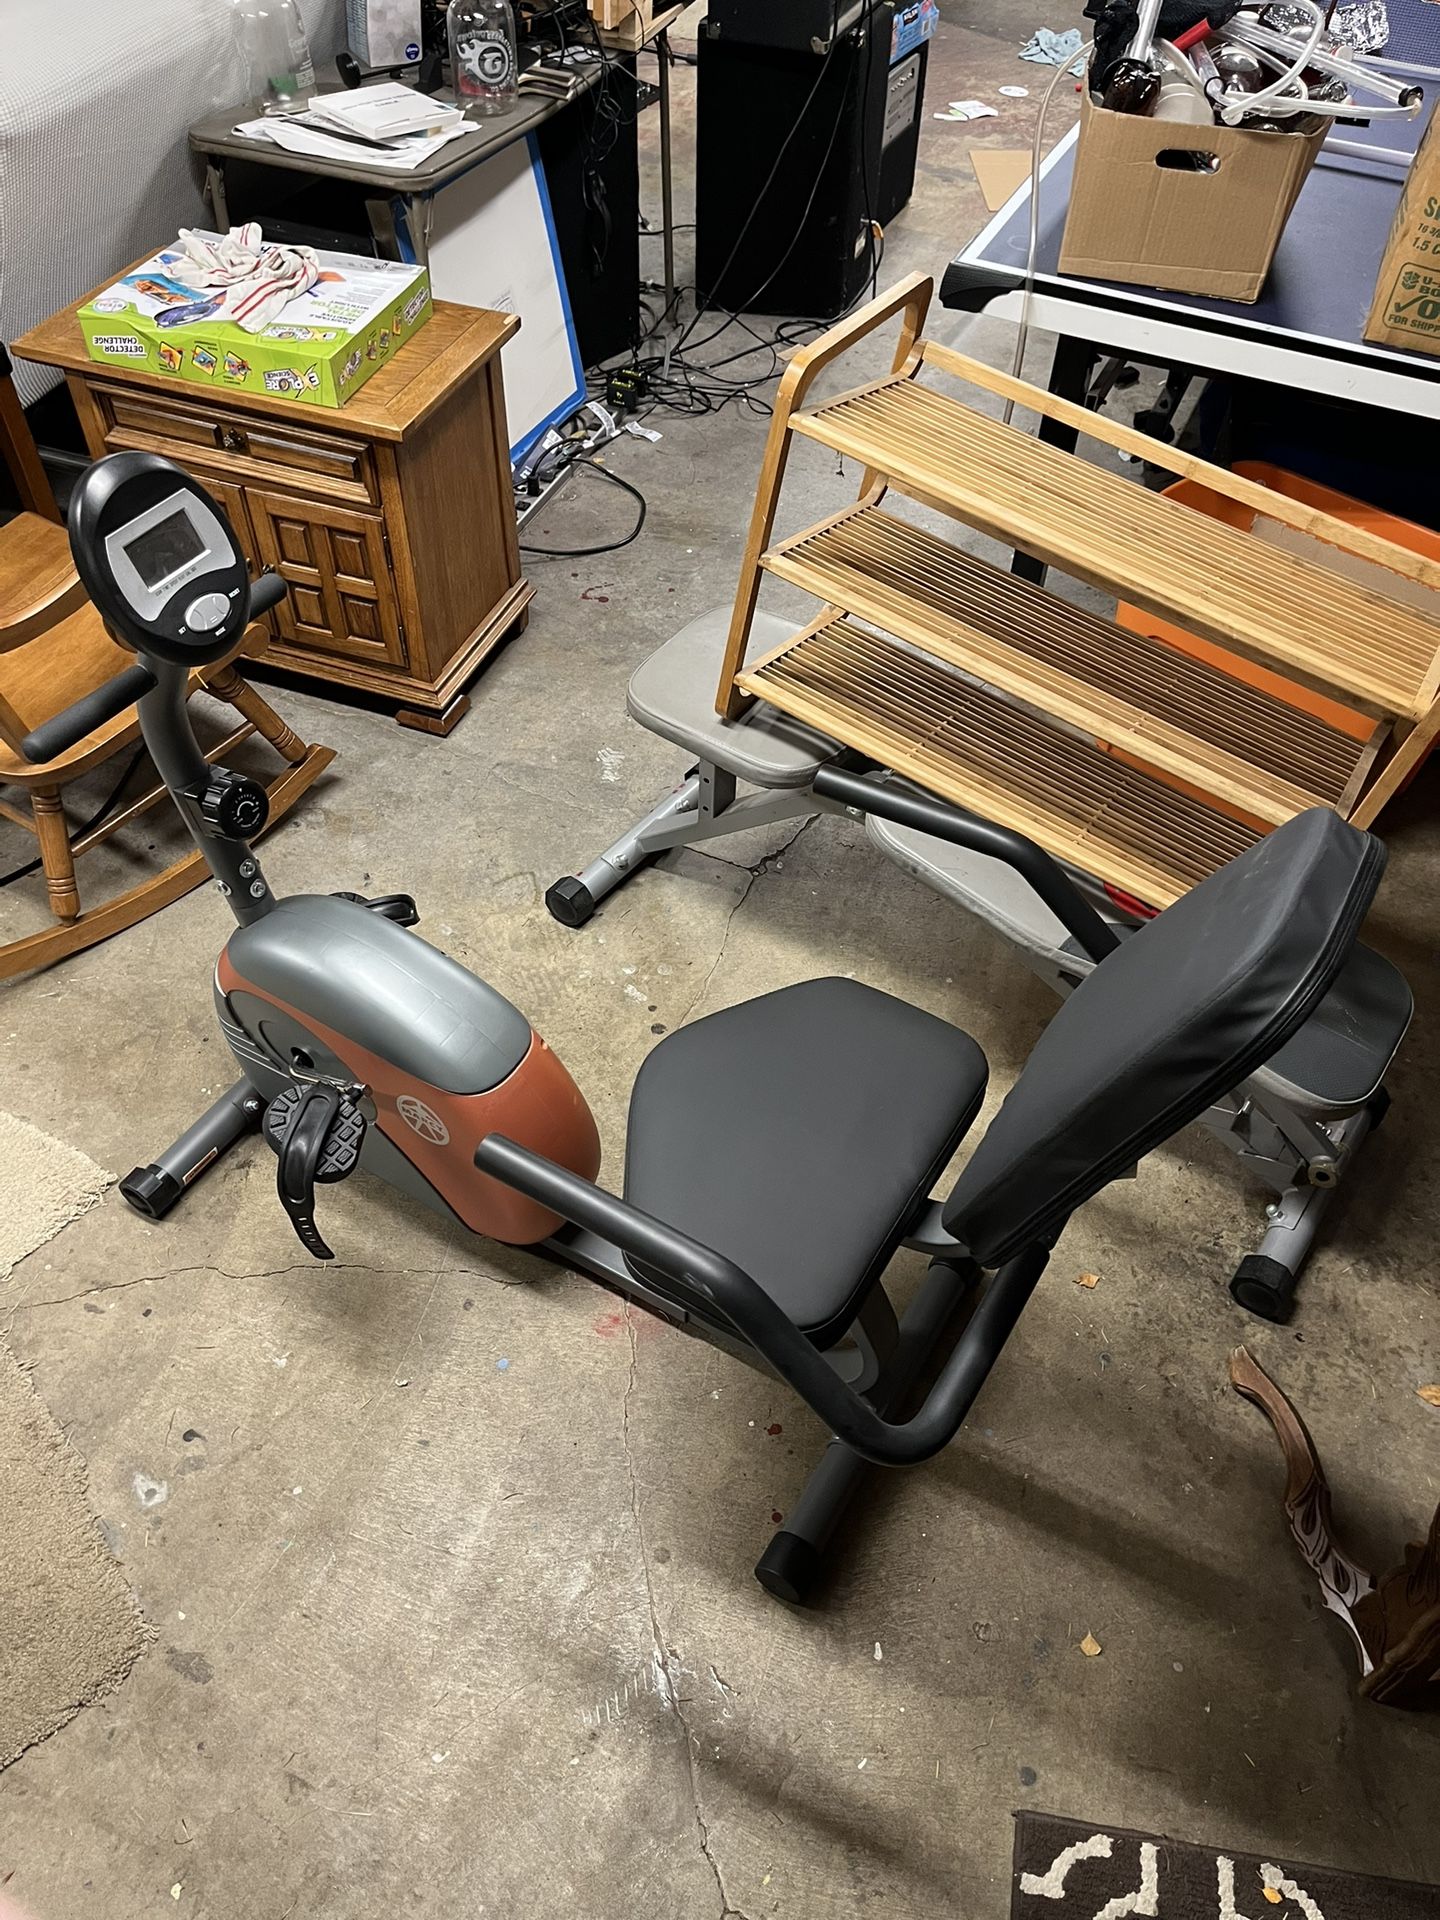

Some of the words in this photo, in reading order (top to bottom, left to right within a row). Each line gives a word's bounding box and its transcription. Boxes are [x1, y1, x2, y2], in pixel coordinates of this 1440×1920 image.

[1412, 236, 1431, 252] 1.5
[1388, 313, 1408, 325] FOR
[94, 336, 138, 345] CHALLENGE
[104, 345, 144, 353] DETECTOR
